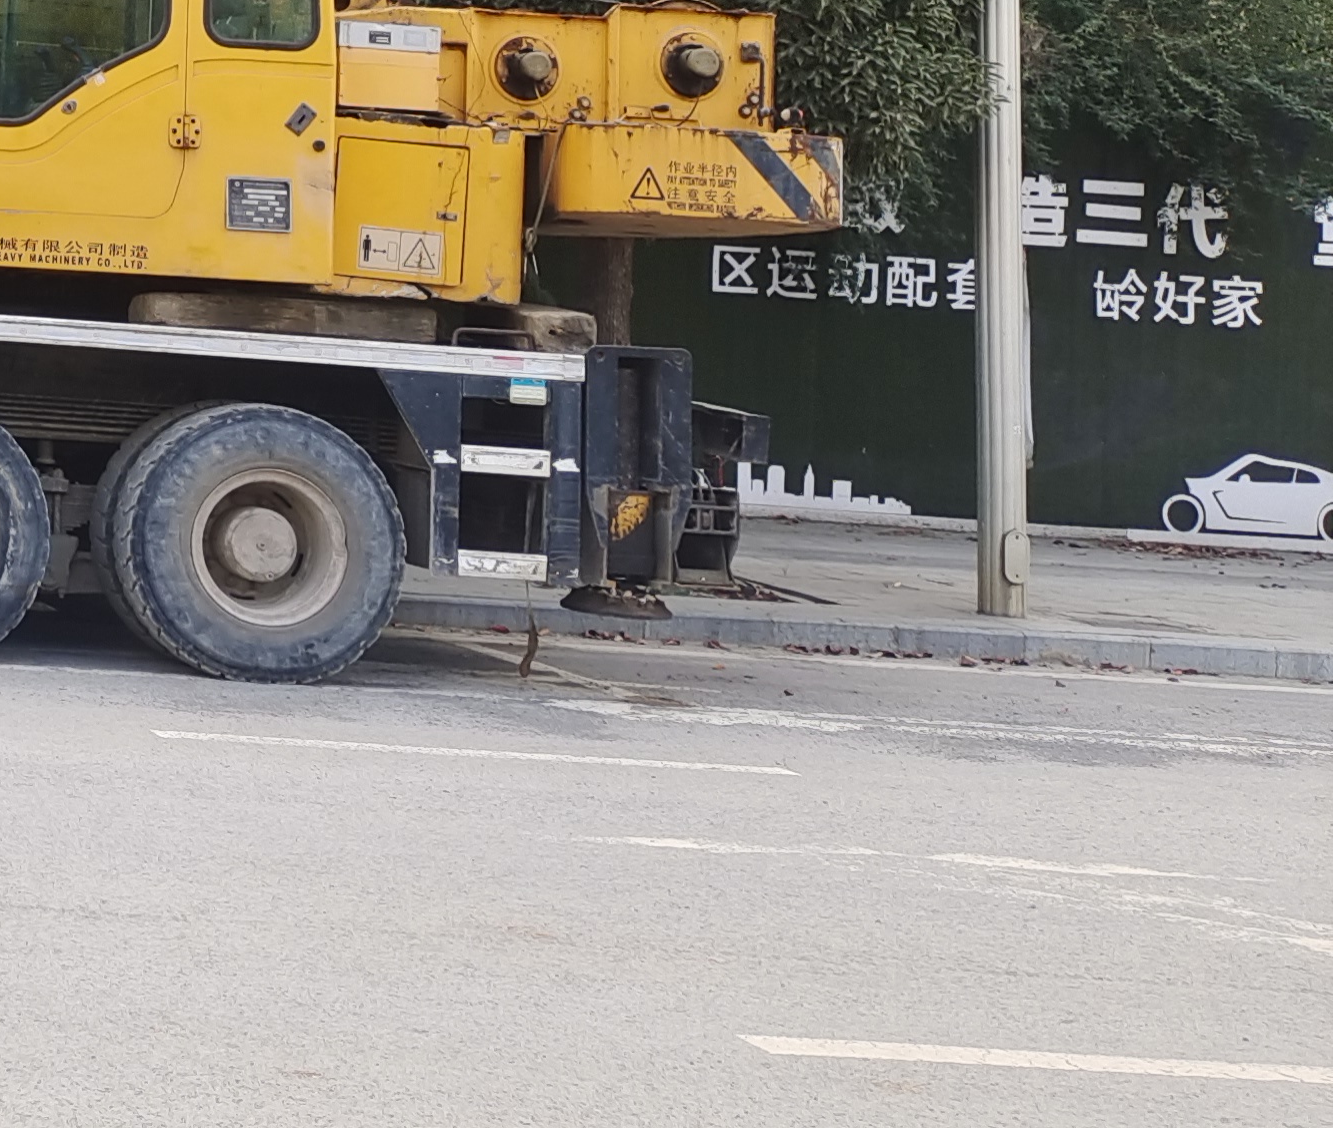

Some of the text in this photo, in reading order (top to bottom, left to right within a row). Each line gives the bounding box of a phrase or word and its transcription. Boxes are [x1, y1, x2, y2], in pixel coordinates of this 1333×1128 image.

[668, 160, 737, 178] 作业半径内
[667, 186, 736, 204] 注意安全
[29, 253, 91, 266] MACHINERY
[1093, 269, 1264, 328] 龄好家
